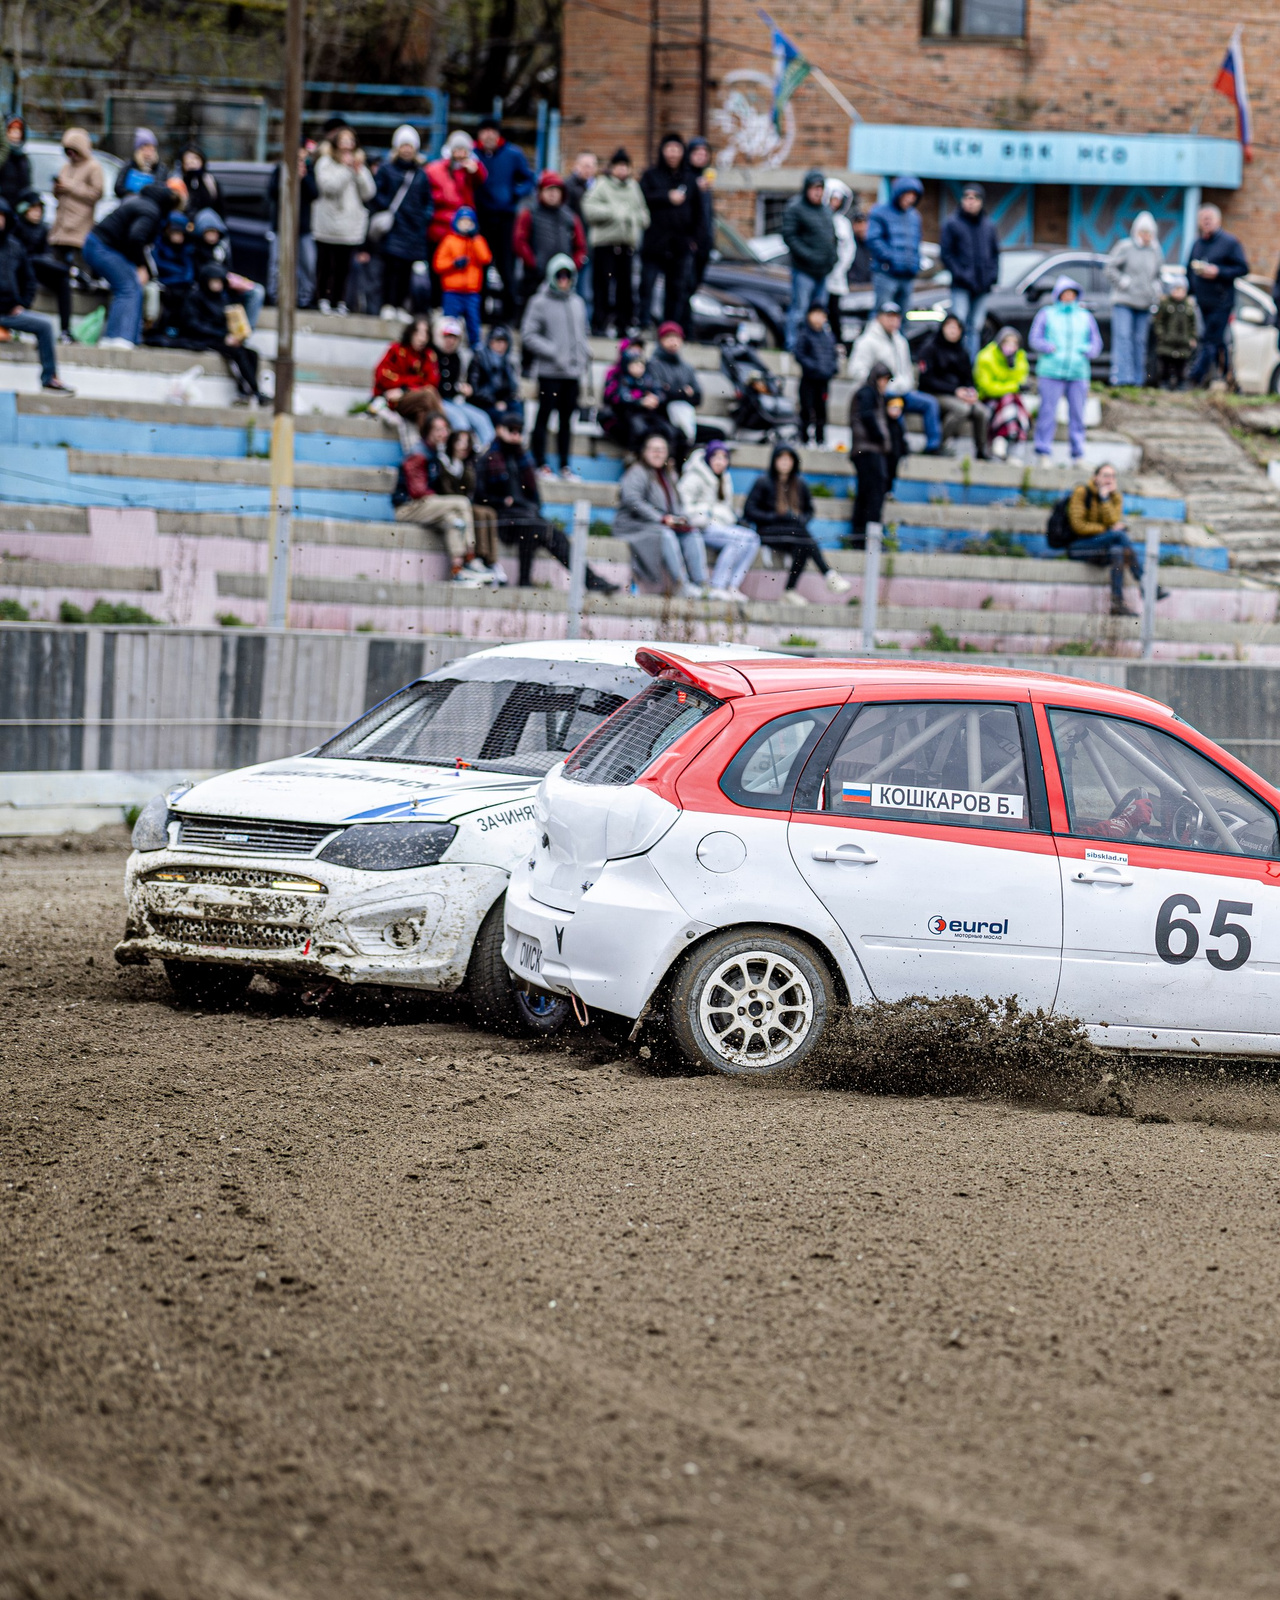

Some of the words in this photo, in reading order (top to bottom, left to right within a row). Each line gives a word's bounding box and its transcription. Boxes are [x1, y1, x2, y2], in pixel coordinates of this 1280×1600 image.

[880, 787, 991, 813] КОШКАРОВ
[997, 797, 1015, 815] Б.
[476, 804, 535, 832] ЗАЧИНЯ
[1086, 852, 1128, 862] sibsklad.ru
[949, 919, 1009, 934] eurol
[1155, 893, 1253, 971] 65
[520, 941, 543, 973] ОМСК
